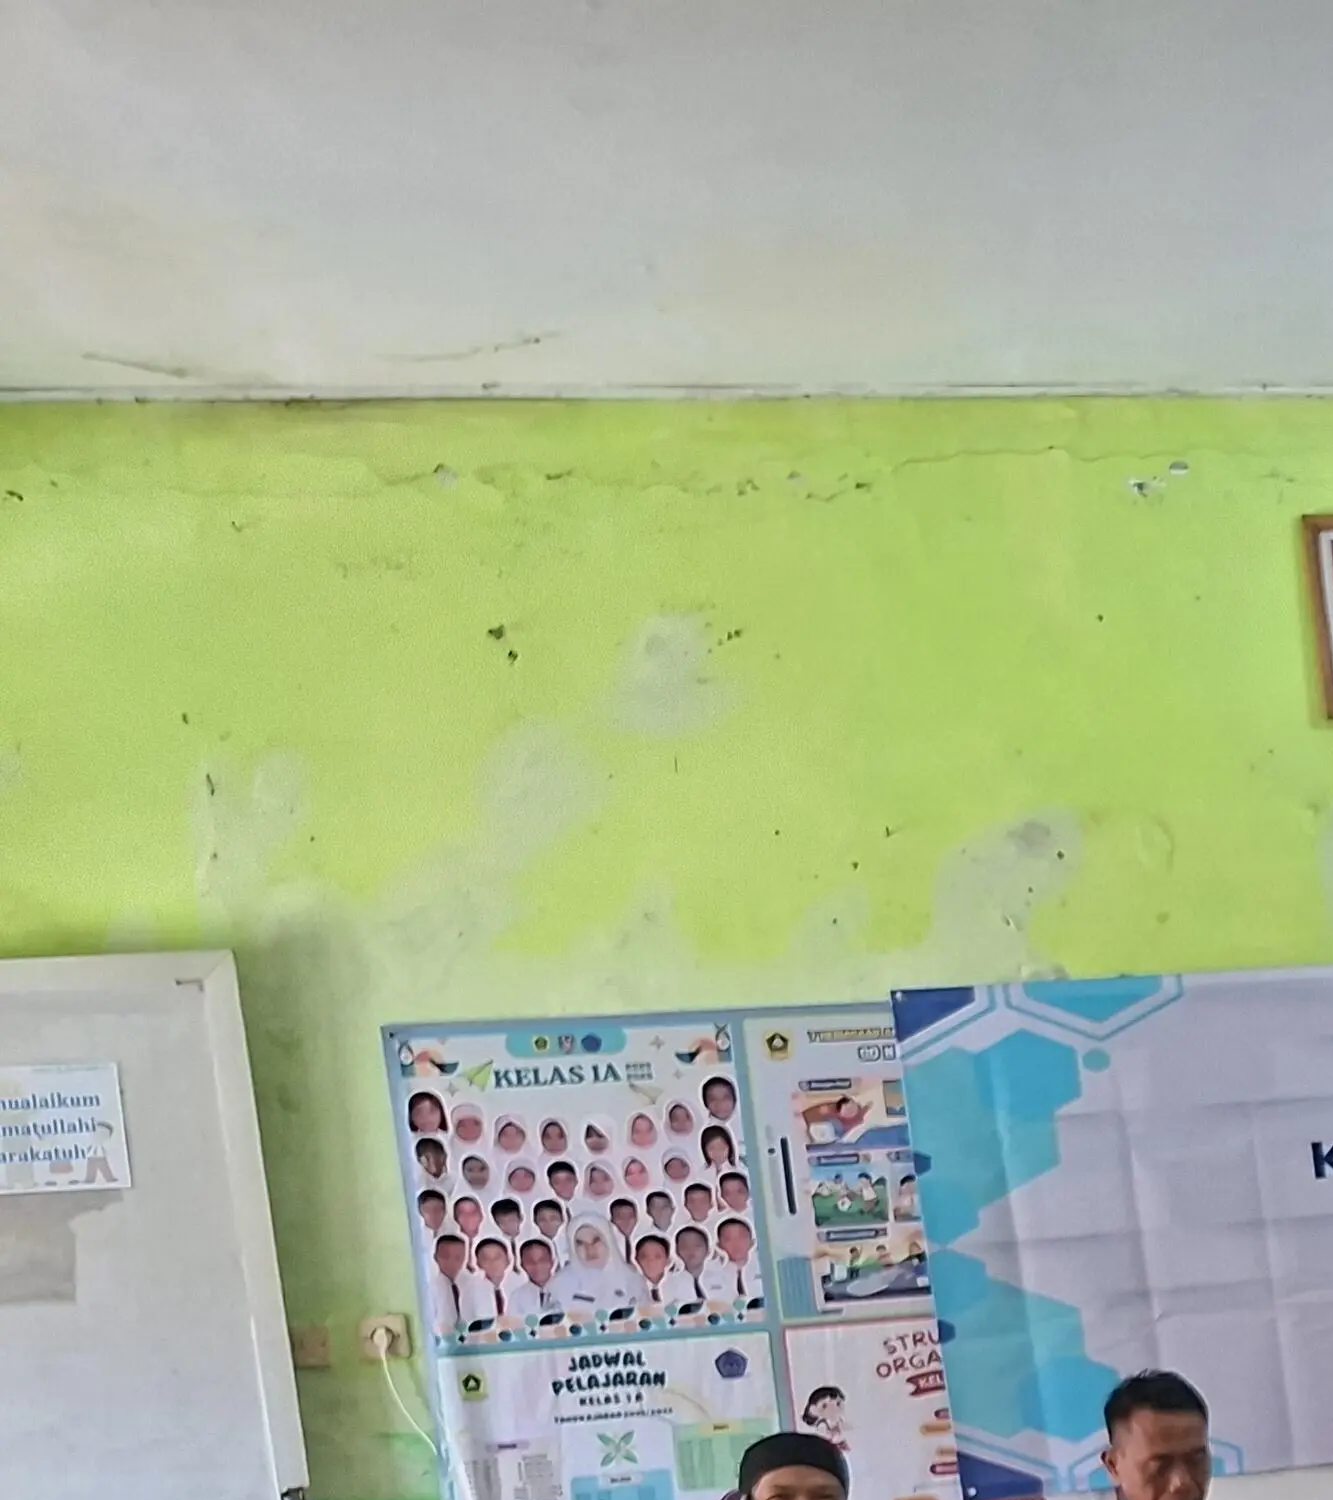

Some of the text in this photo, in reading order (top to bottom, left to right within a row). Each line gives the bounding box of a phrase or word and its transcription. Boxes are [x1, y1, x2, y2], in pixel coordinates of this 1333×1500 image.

[494, 1064, 585, 1088] KELAS
[568, 1349, 647, 1372] JADWAL
[551, 1370, 667, 1397] PELAJARAN
